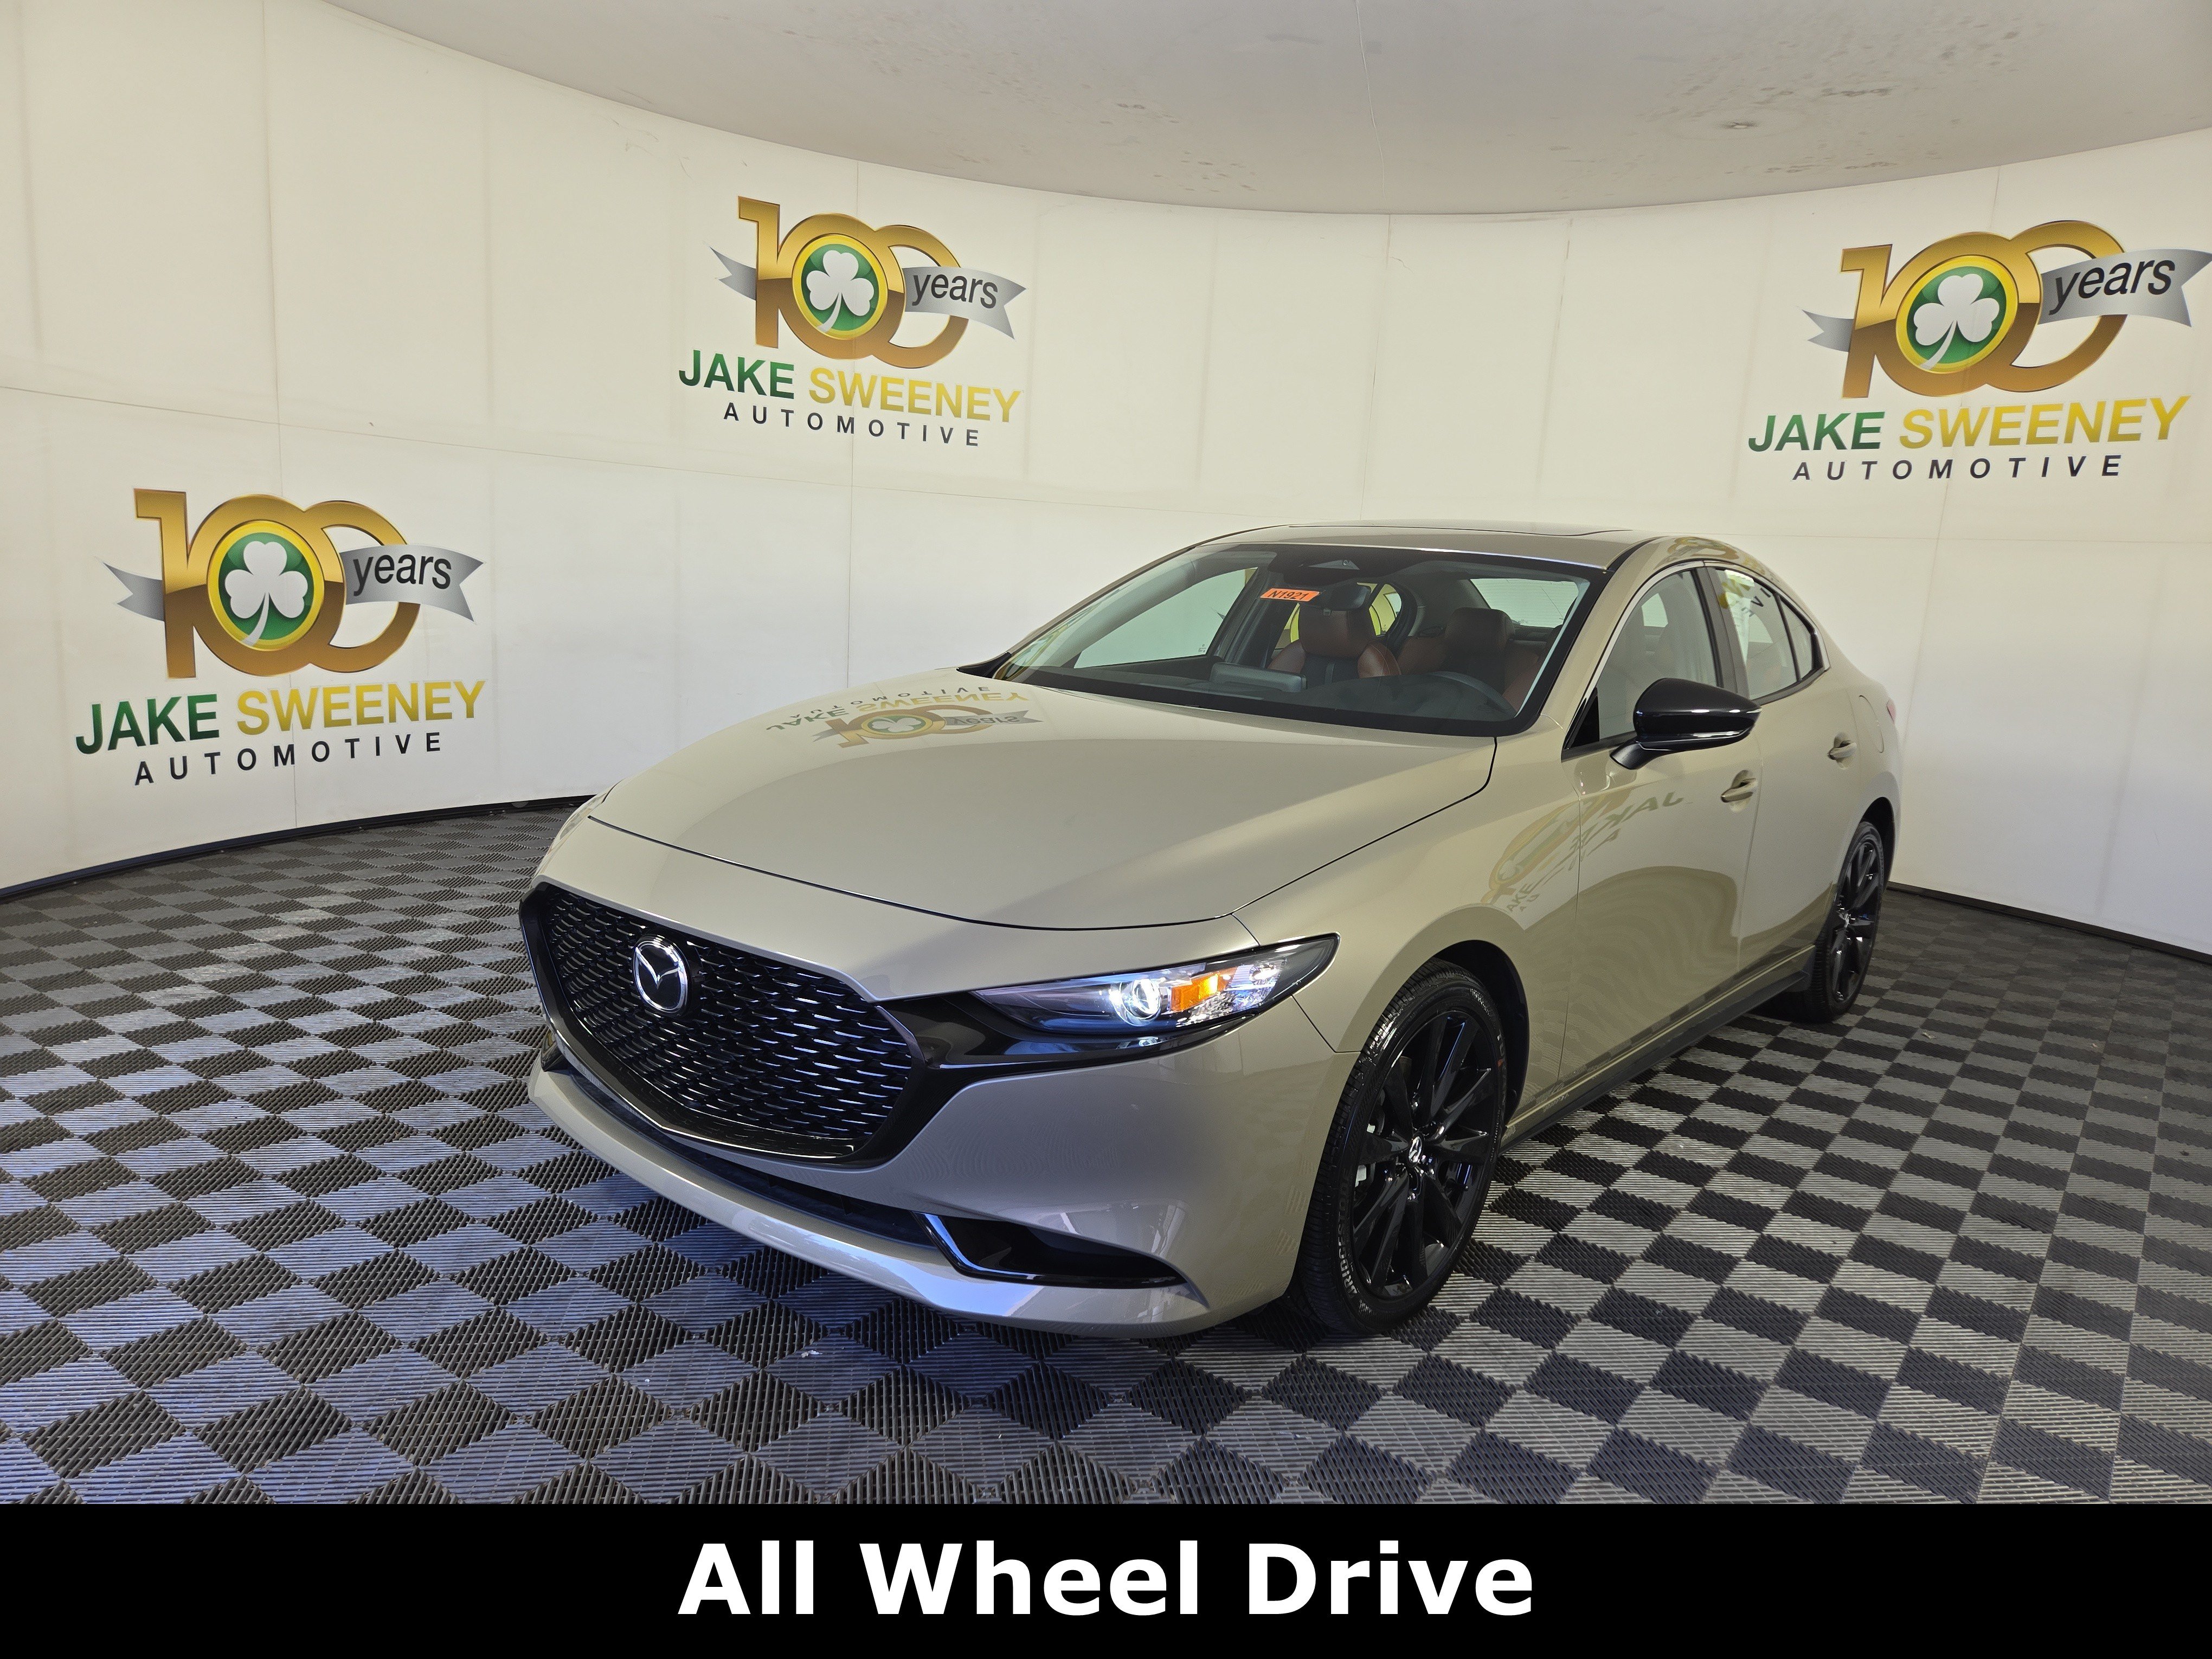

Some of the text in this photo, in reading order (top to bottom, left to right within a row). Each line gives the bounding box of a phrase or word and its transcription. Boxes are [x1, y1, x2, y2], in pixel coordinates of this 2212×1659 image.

[911, 273, 999, 309] years
[2049, 259, 2176, 315] years
[679, 350, 1021, 423] JAKE SWEENEY
[724, 402, 979, 447] AUTOMOTIVE
[1748, 395, 2191, 452] JAKE SWEENEY
[1793, 454, 2121, 480] AUTOMOTIVE
[353, 554, 452, 596] years
[1268, 590, 1309, 600] N1921
[76, 680, 485, 755] JAKE SWEENEY
[135, 732, 441, 786] AUTOMOTIVE
